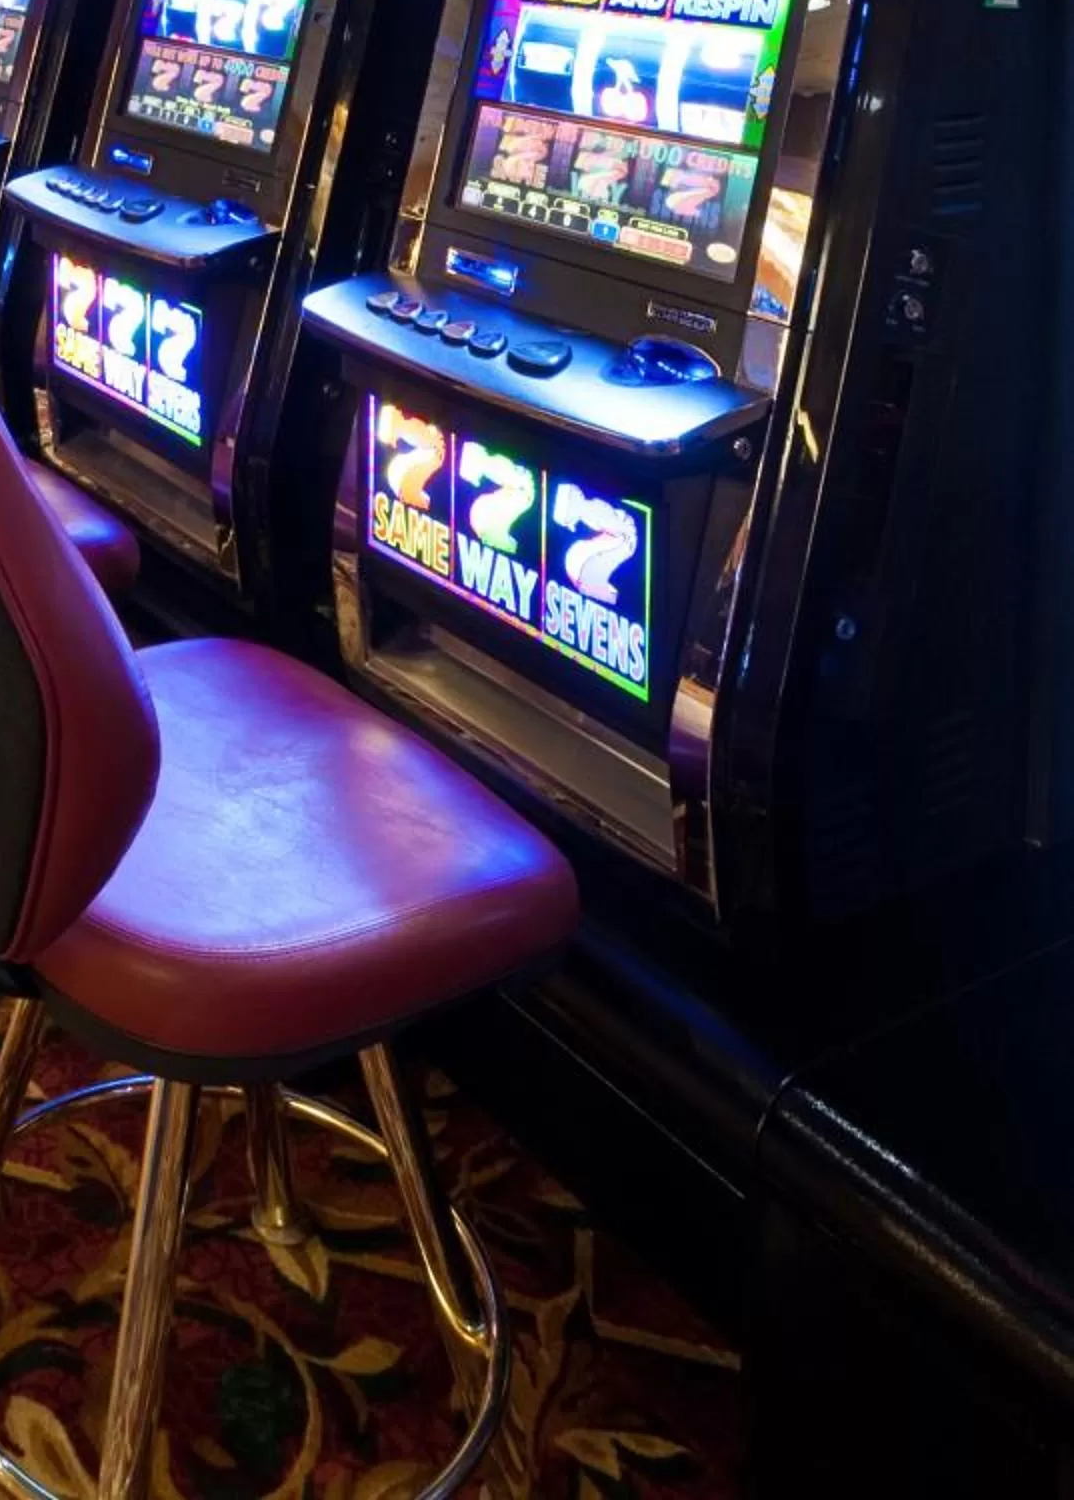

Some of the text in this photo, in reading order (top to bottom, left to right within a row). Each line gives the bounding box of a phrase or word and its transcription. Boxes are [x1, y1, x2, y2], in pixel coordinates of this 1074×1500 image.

[374, 492, 645, 683] SAME WAY SEVENS
